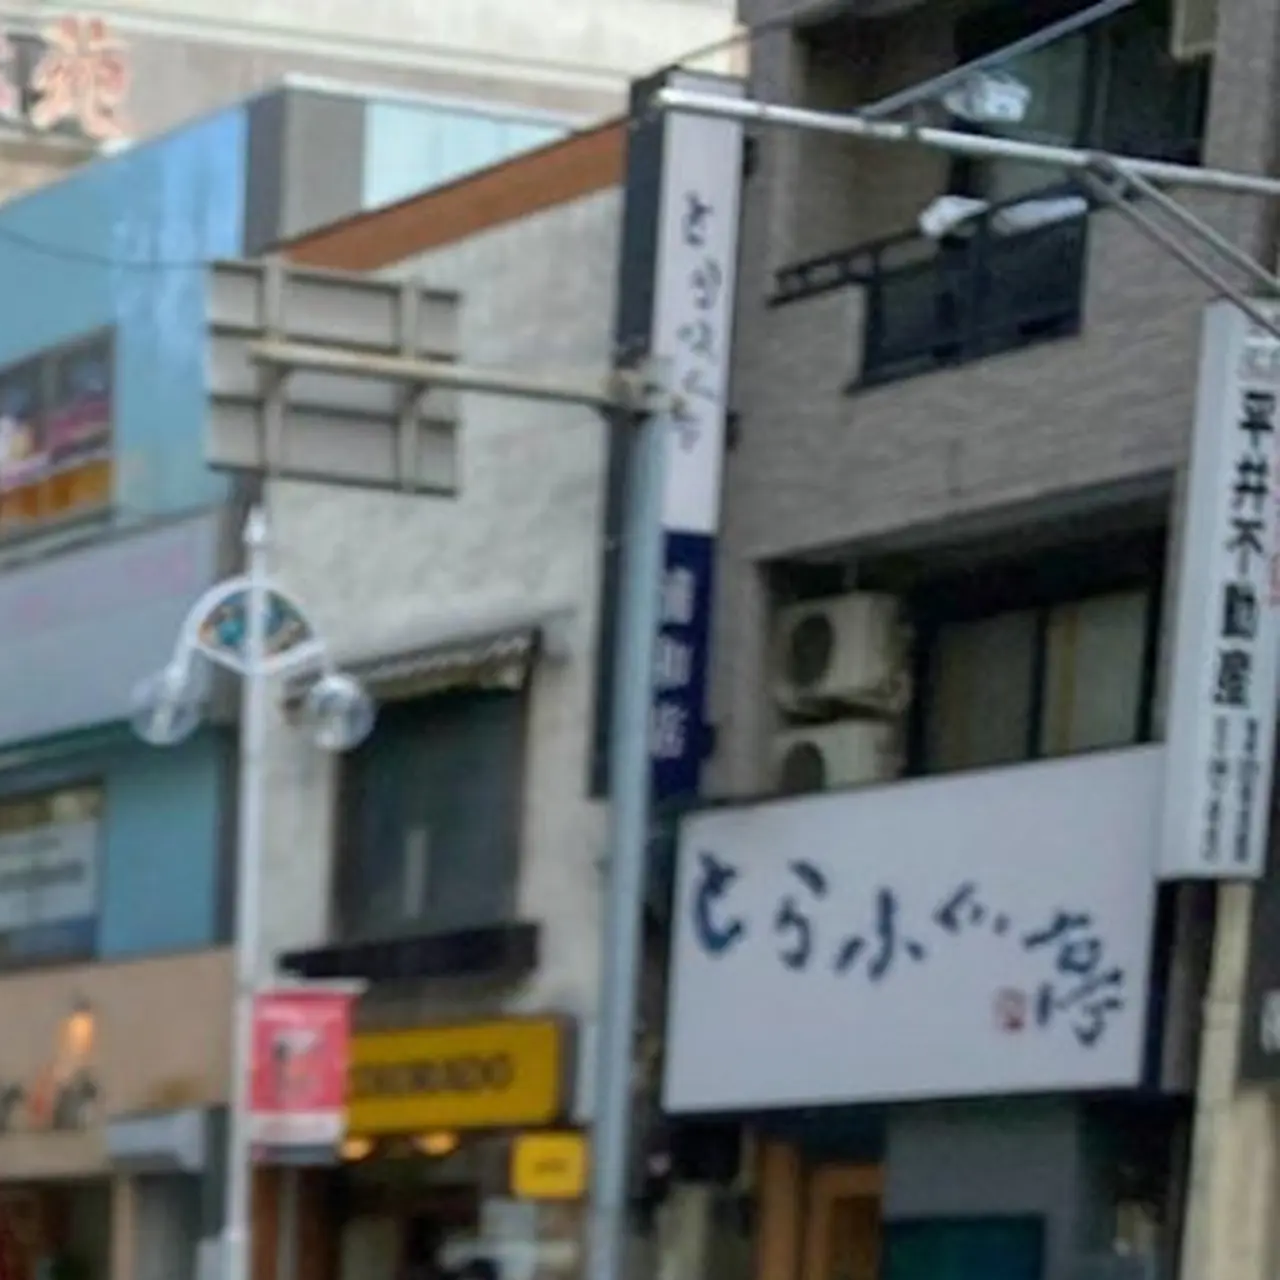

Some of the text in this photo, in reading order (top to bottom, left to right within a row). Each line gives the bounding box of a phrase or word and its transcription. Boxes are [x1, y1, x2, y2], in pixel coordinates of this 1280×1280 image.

[692, 850, 1126, 1048] とらふぐ亭
